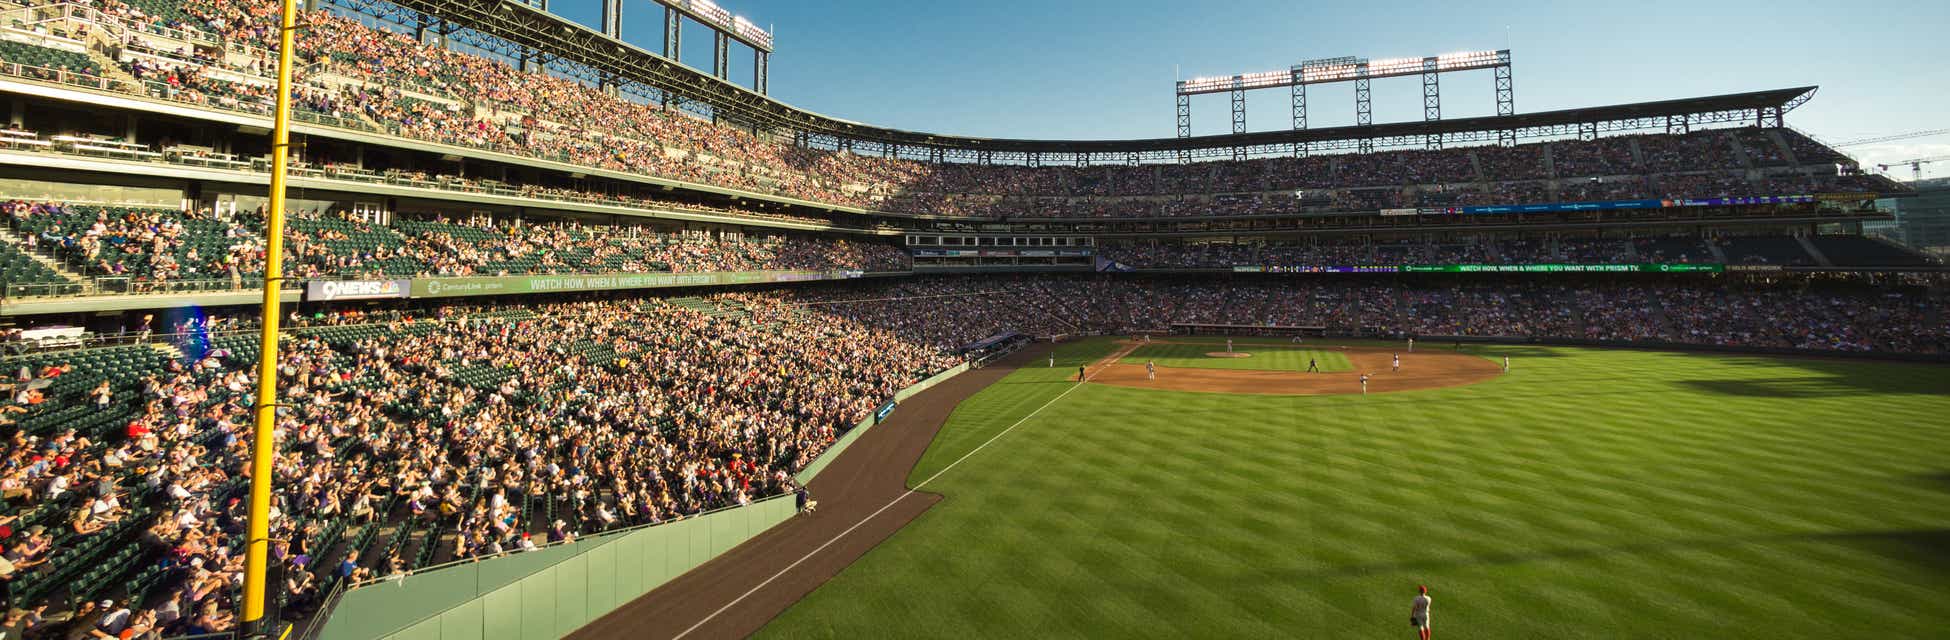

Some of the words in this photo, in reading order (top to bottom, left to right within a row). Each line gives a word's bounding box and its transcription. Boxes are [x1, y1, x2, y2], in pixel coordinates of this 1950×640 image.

[1605, 264, 1628, 272] PRISM
[531, 279, 561, 290] WATCH
[587, 277, 609, 288] WHEN
[611, 277, 617, 287] &
[619, 276, 641, 287] WHERE
[658, 275, 677, 285] WANT
[323, 281, 381, 300] 9NEWS
